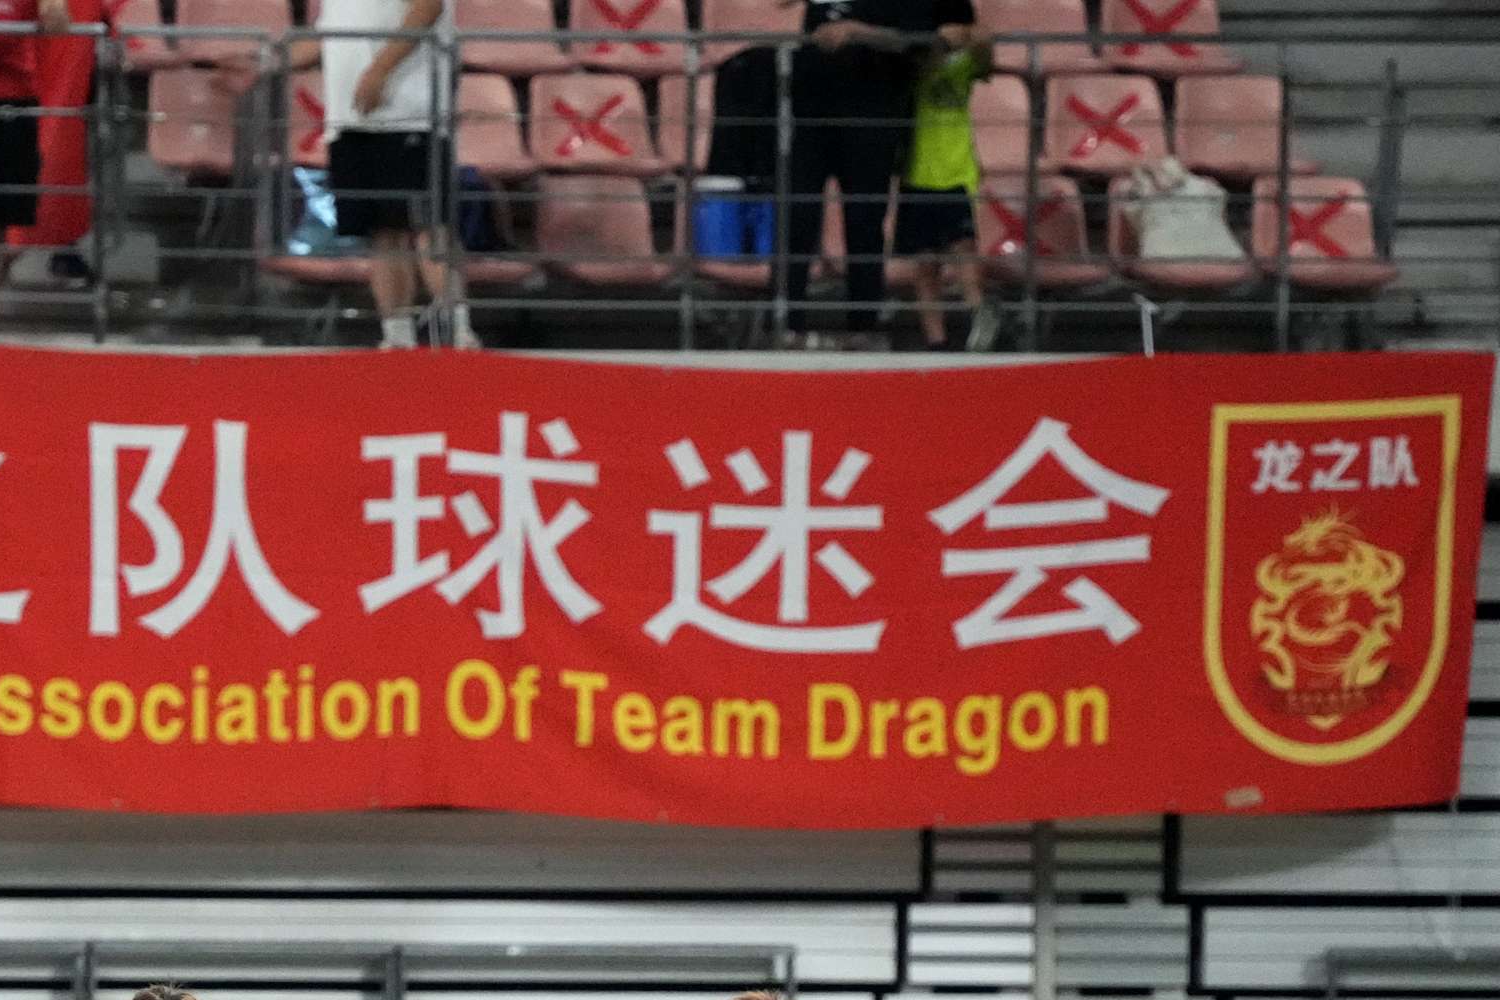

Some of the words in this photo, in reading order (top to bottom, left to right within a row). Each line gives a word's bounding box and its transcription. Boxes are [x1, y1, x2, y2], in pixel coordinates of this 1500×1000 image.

[1252, 436, 1418, 491] 龙之队
[447, 660, 538, 740] Of
[562, 671, 779, 757] Team
[809, 684, 1107, 773] Dragon
